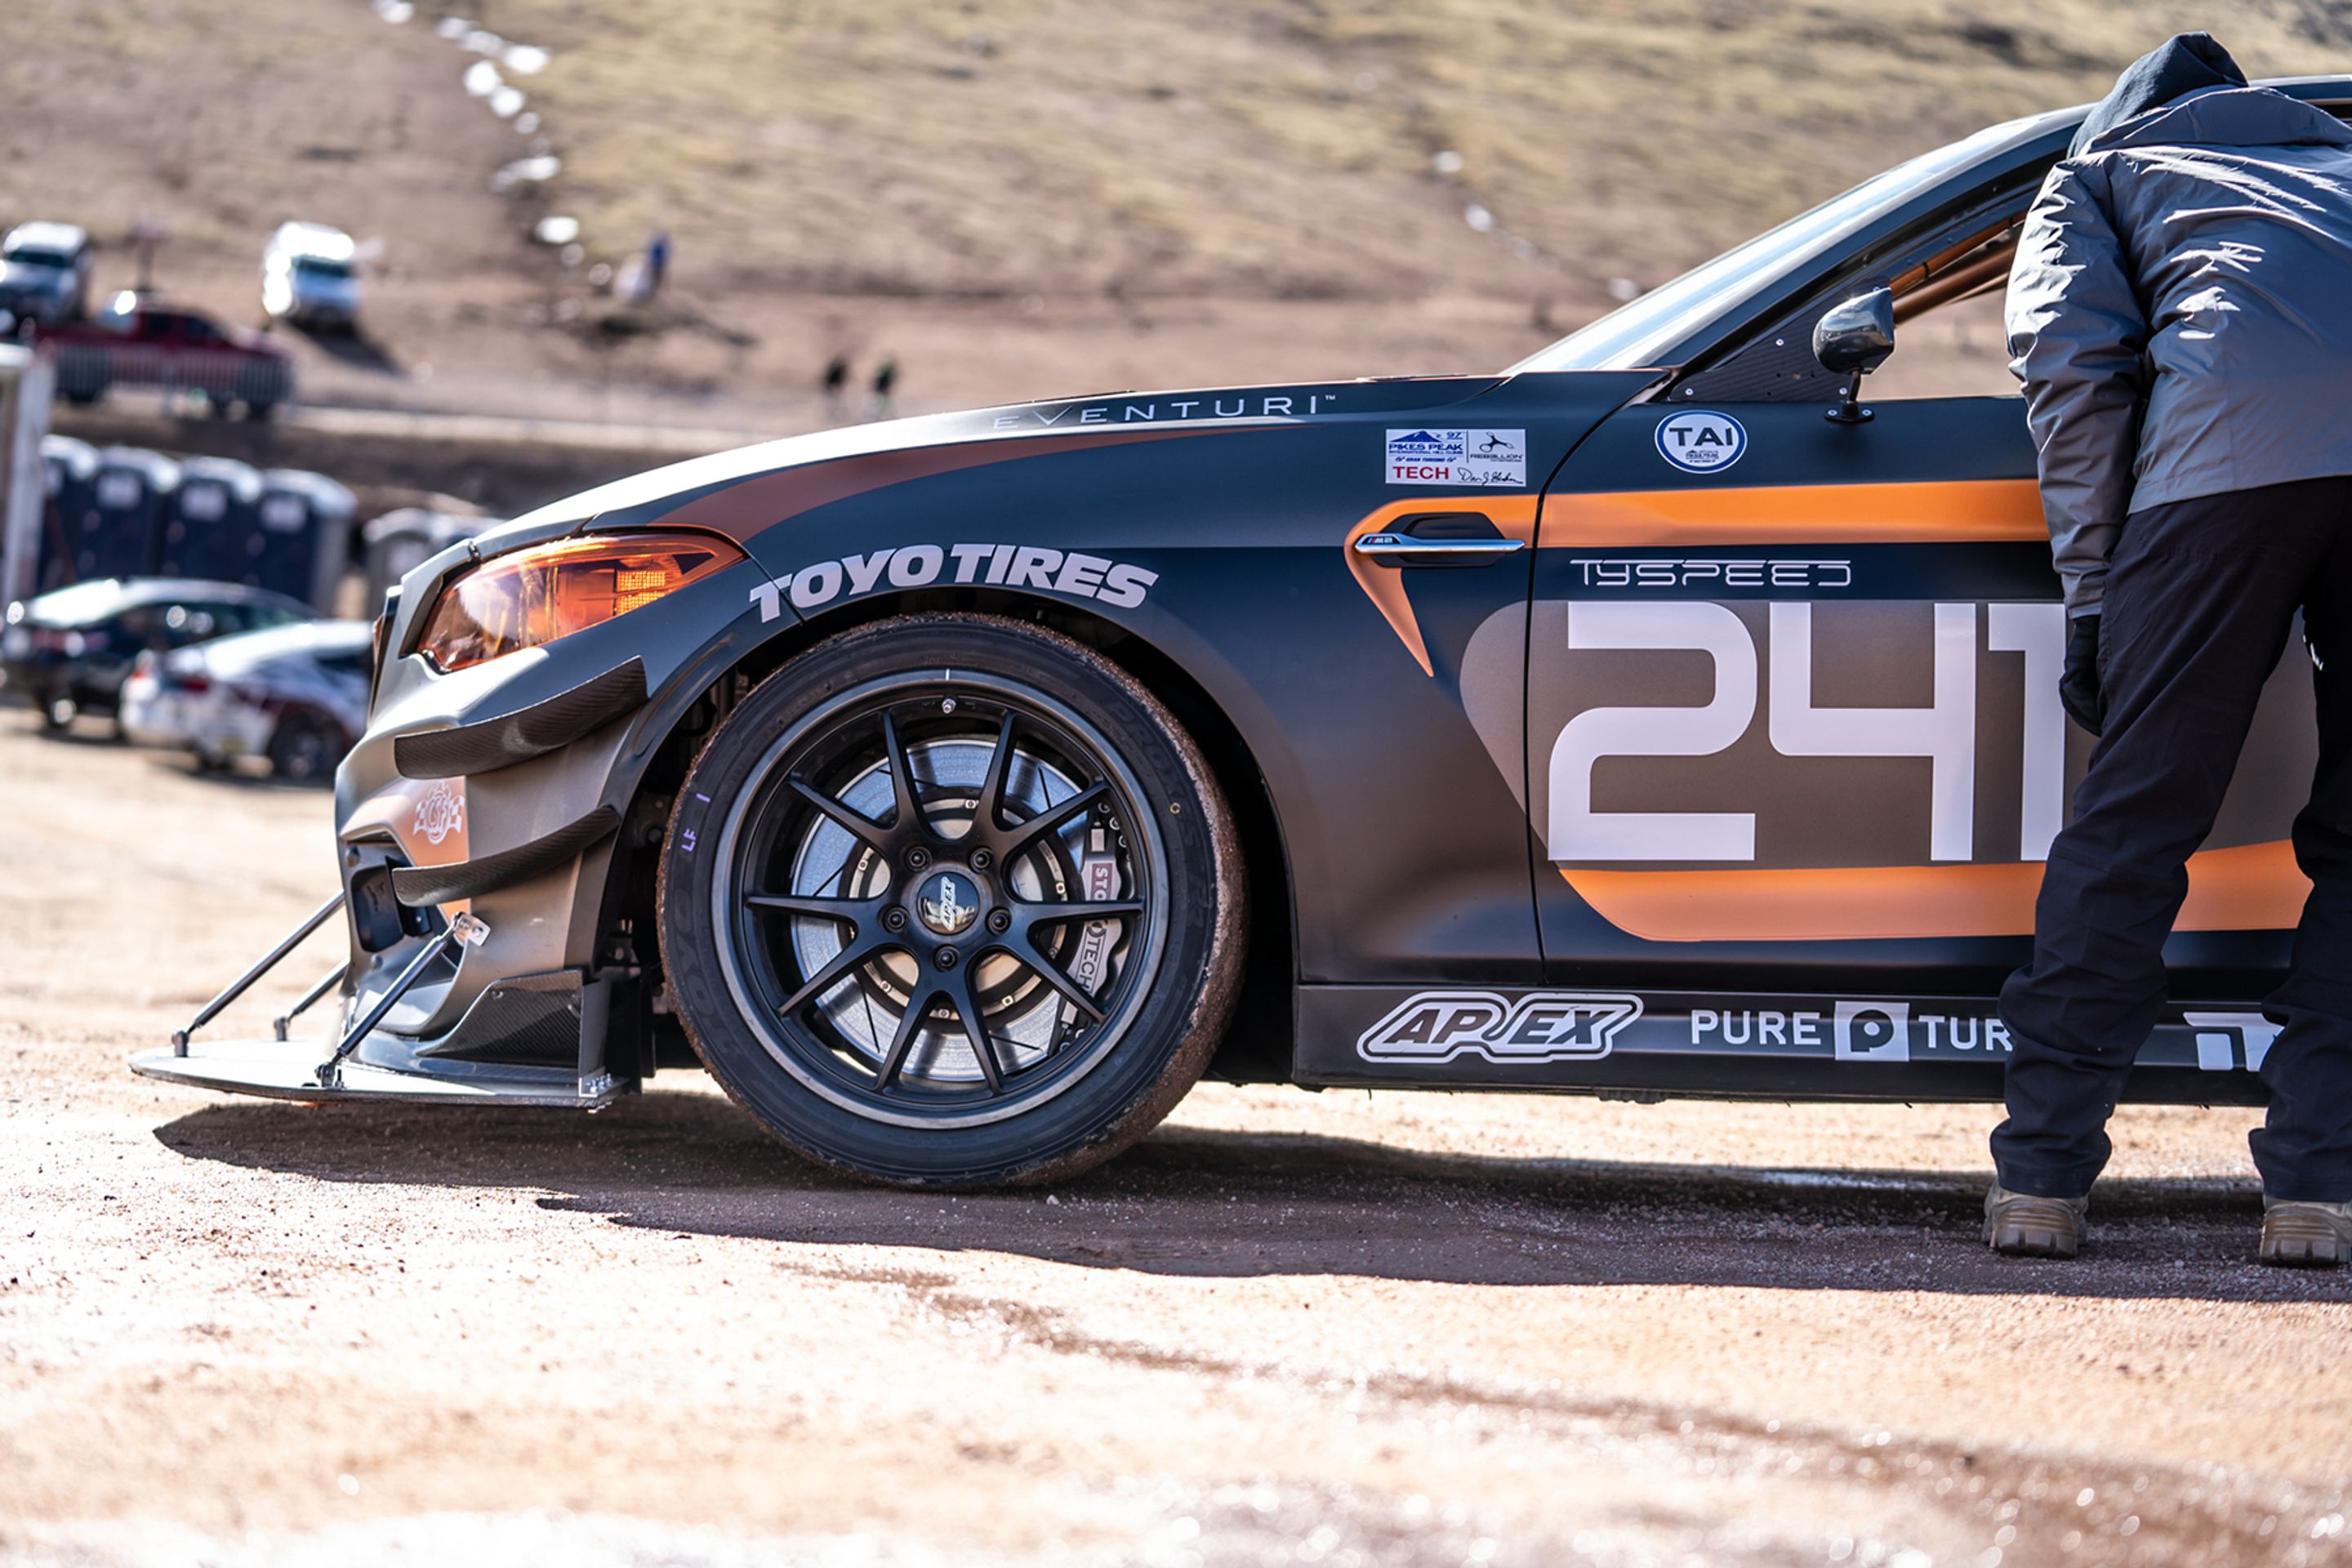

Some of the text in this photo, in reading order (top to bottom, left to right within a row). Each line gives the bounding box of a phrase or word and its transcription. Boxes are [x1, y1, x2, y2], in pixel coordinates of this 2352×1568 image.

[1392, 466, 1449, 479] TECH
[750, 543, 1159, 623] TOYO TIRES
[1570, 559, 1851, 586] TYSPEED
[1548, 601, 2066, 861] 241
[1367, 1000, 1635, 1054] APEX
[1691, 1009, 1821, 1045] PURE
